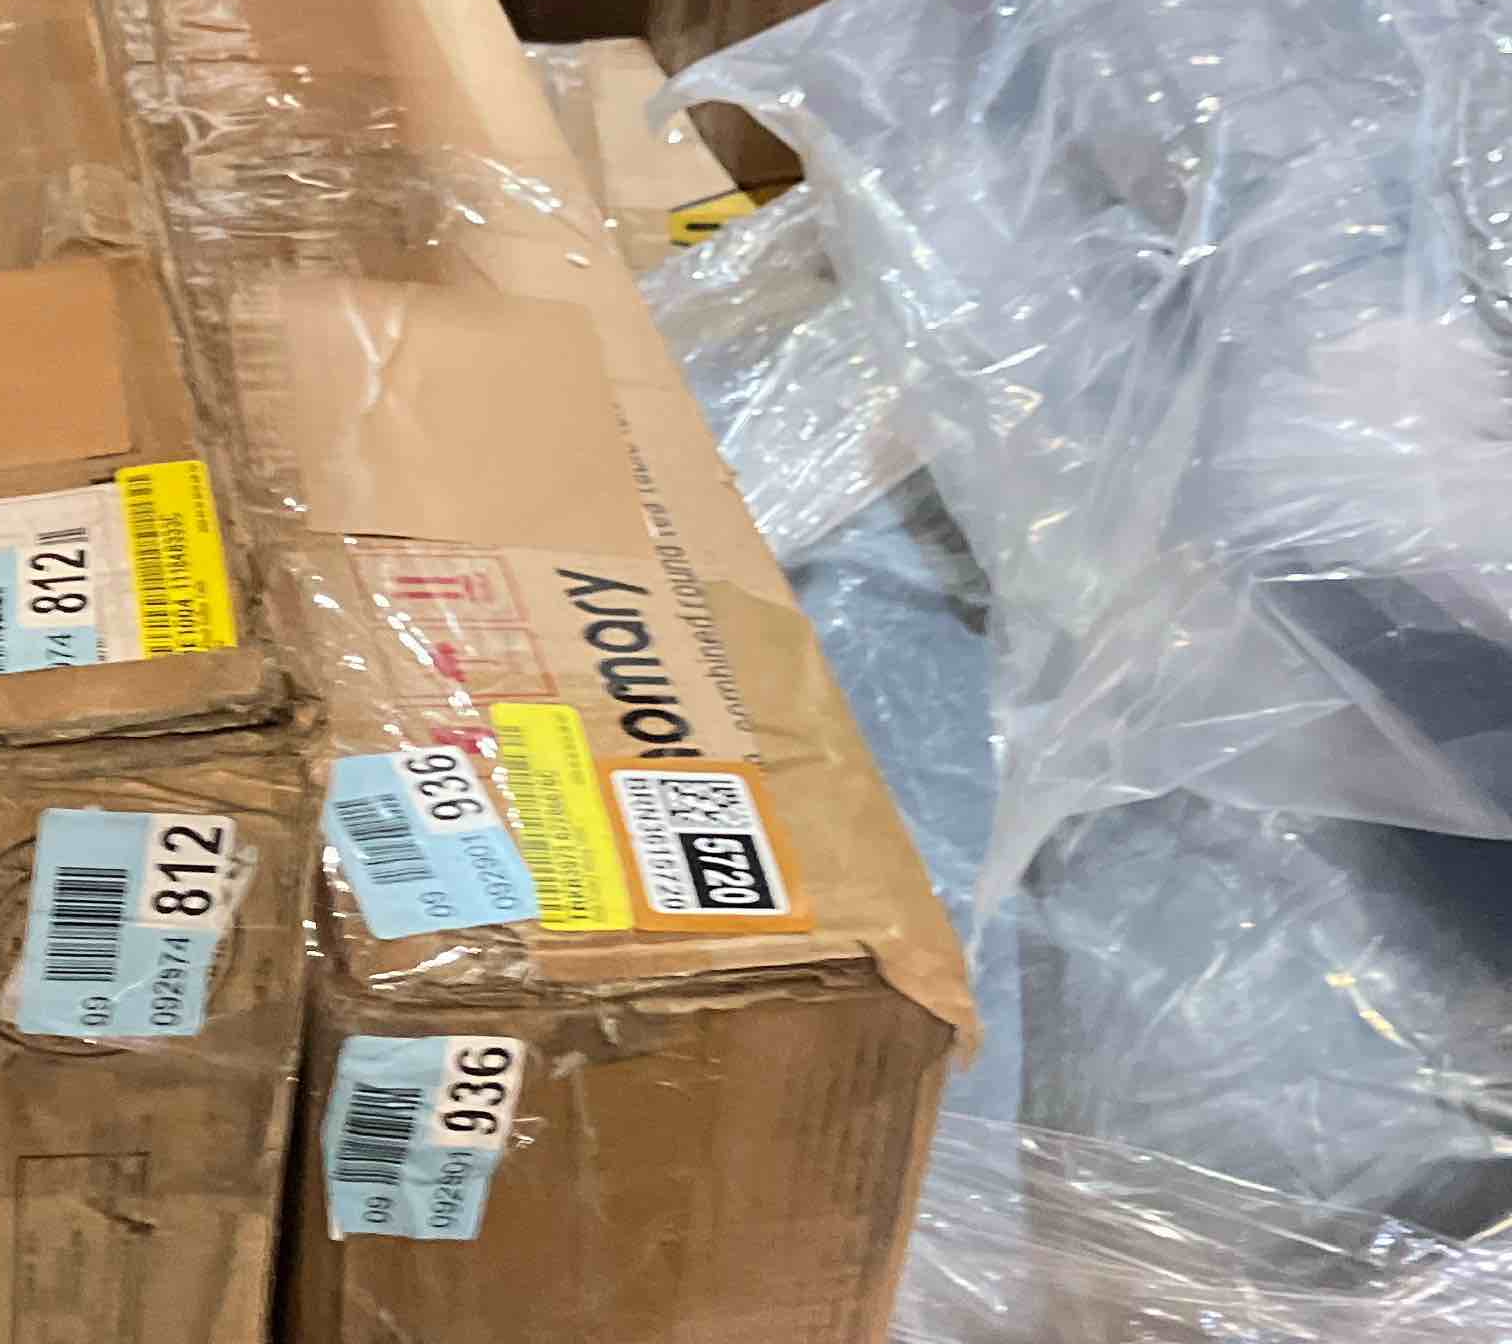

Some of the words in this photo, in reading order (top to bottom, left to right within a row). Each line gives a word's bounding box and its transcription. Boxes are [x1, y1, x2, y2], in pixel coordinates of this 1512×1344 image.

[31, 547, 88, 615] 812
[404, 753, 483, 821] 936
[152, 824, 225, 919] 812
[80, 995, 113, 1028] 09
[441, 1046, 513, 1136] 936
[362, 1195, 394, 1225] 09
